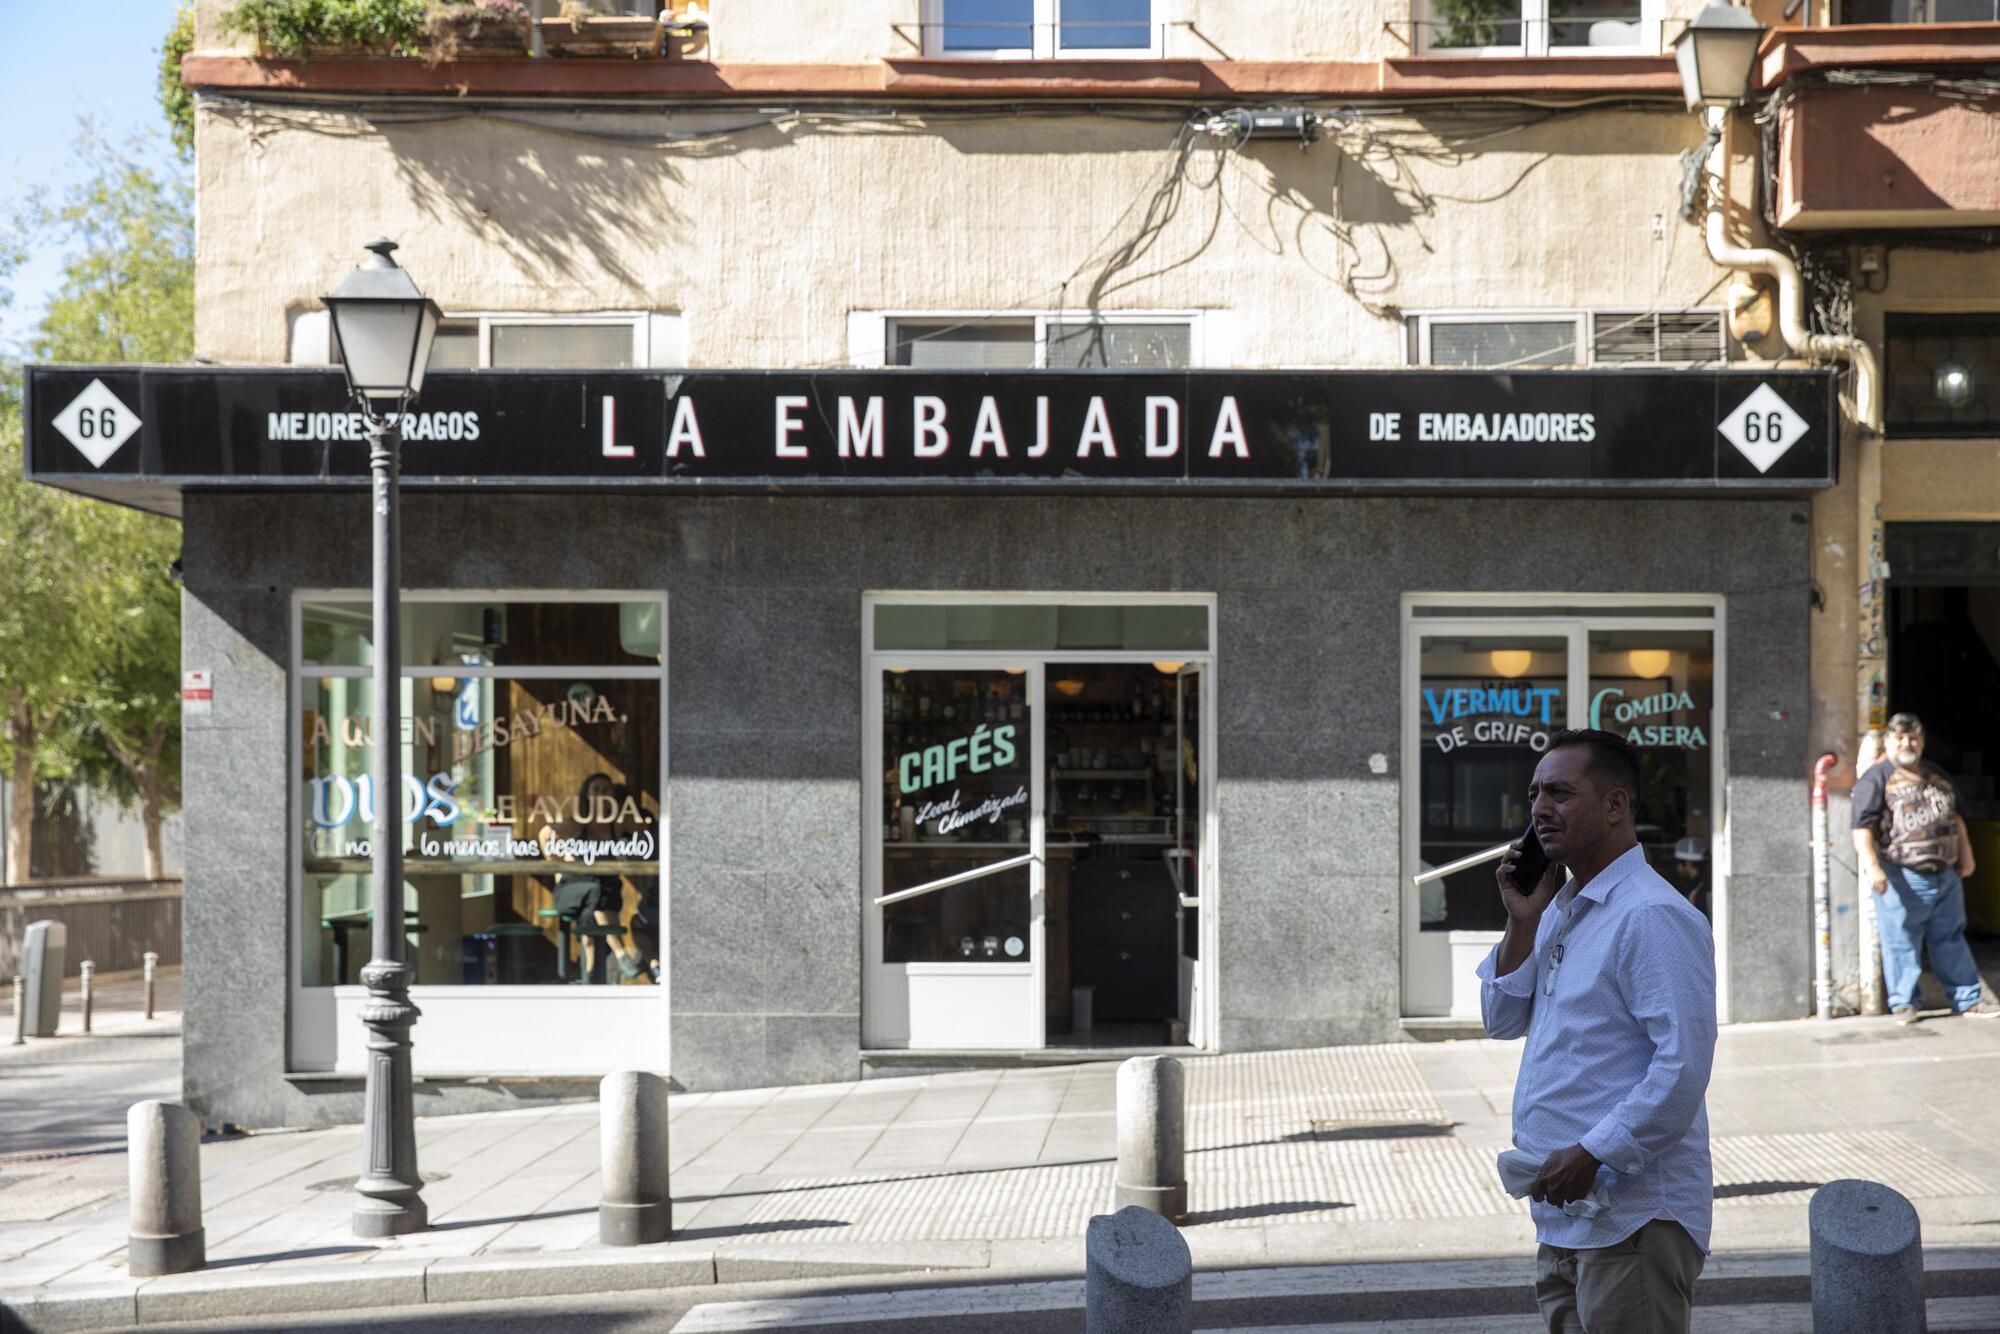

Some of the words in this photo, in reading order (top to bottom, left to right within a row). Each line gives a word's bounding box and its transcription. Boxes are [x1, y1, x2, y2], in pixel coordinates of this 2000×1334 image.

[79, 407, 117, 439] 66
[601, 395, 706, 458] LA
[774, 395, 1251, 458] EMBAJADA
[1369, 412, 1401, 442] DE
[1418, 412, 1596, 442] EMBAJADORES
[1743, 411, 1783, 443] 66
[1422, 686, 1560, 727] VERMUT
[1434, 725, 1469, 754] DE
[1473, 720, 1551, 753] GRIFO
[899, 723, 1016, 795] CAFÉS
[528, 795, 653, 824] AYUDA.
[420, 832, 440, 857] lo
[505, 831, 541, 857] has
[544, 830, 655, 866] desayunado)
